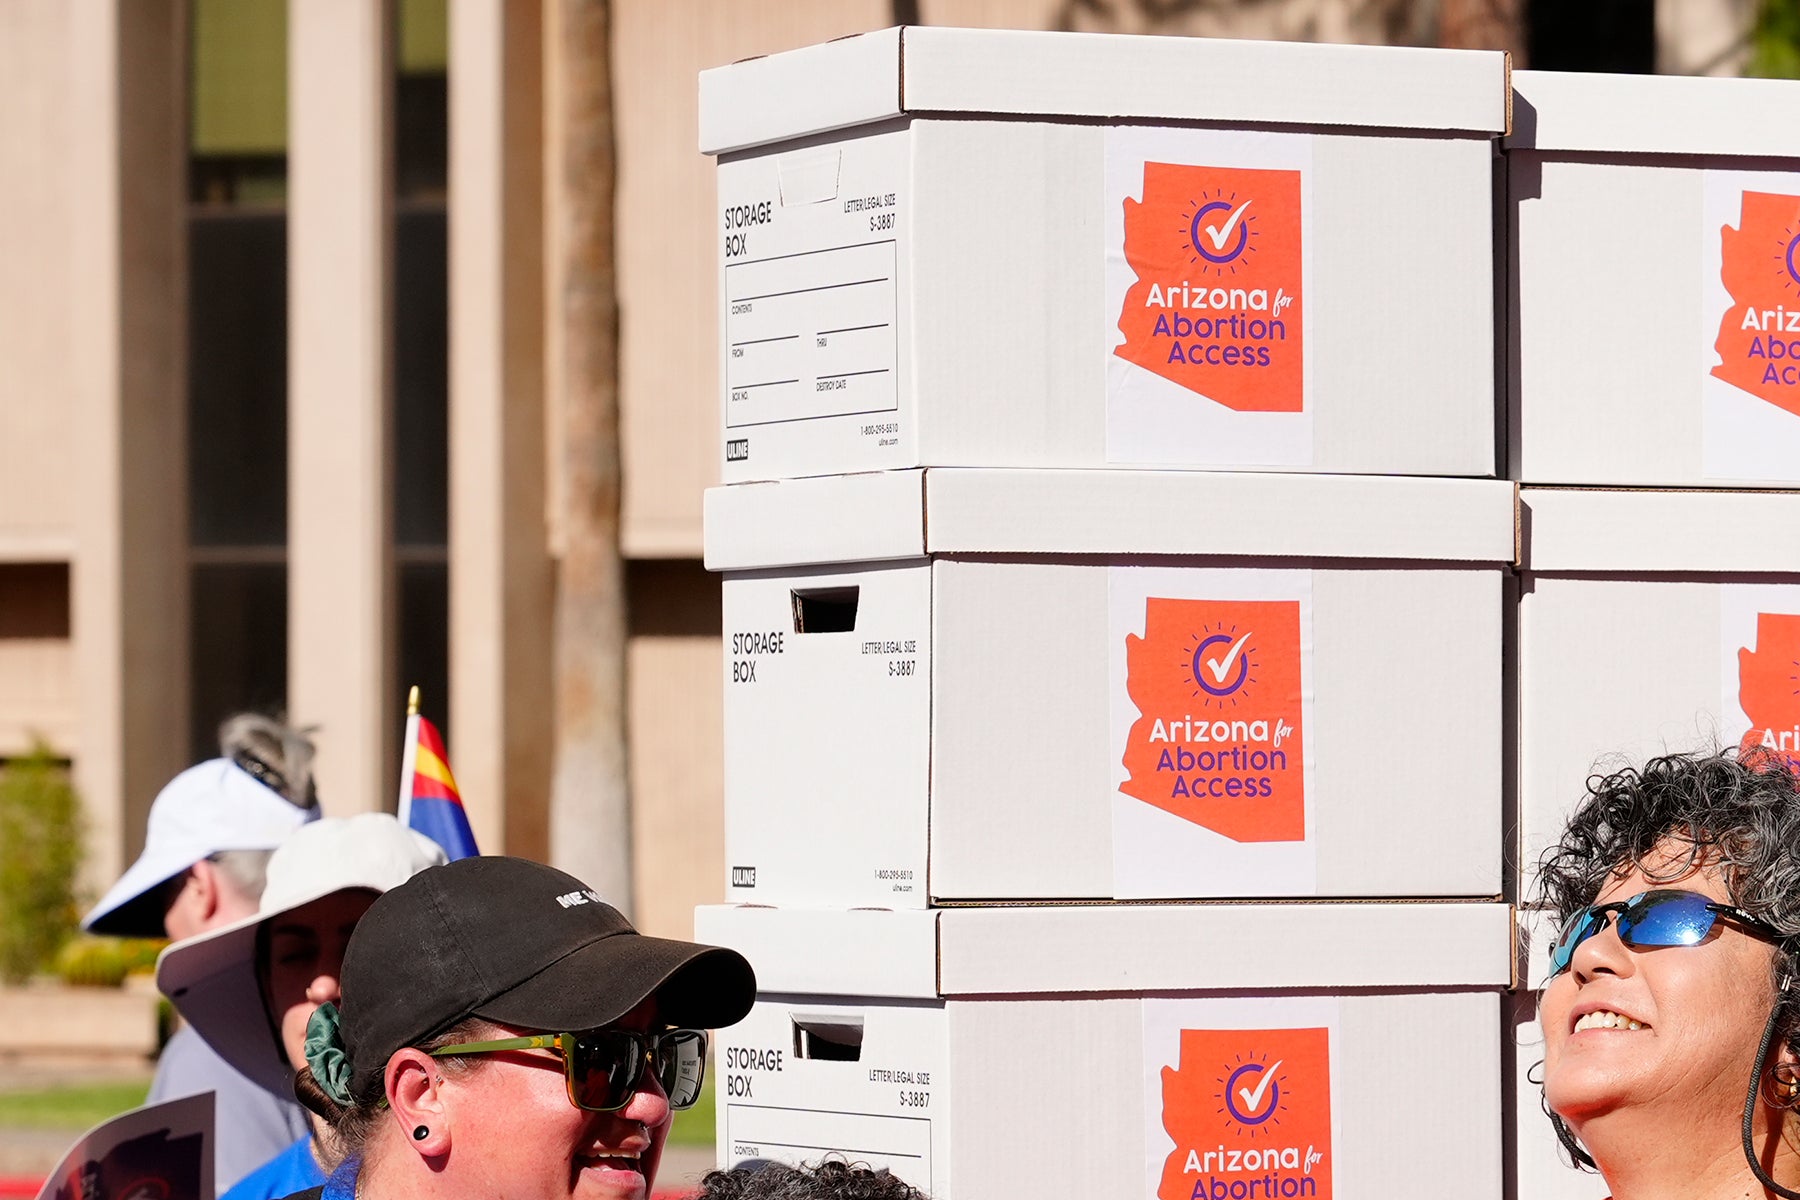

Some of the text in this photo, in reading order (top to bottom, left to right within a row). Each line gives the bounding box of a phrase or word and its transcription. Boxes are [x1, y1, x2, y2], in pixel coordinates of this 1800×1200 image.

[884, 193, 896, 206] SIZE
[725, 201, 771, 229] STORAGE
[869, 213, 896, 231] S-3887
[726, 233, 747, 257] BOX
[1145, 280, 1293, 317] Arizona for
[731, 304, 752, 315] CONTENTS
[1152, 311, 1285, 340] Abortion
[732, 349, 744, 358] FROM
[1167, 340, 1271, 367] Access
[816, 379, 847, 392] DESTROY DATE
[860, 423, 898, 436] 1-800-295-5510
[727, 440, 748, 460] ULINE
[878, 437, 899, 447] uline.com
[733, 631, 784, 655] STORAGE
[904, 641, 916, 653] SIZE
[733, 661, 756, 683] BOX
[888, 660, 916, 676] S-3887
[1149, 715, 1294, 748] Arizona for
[1156, 745, 1286, 771] Abortion
[1171, 775, 1272, 798] Access
[733, 867, 755, 886] ULINE
[874, 869, 913, 880] 1-800-295-5510
[893, 884, 912, 892] uline.com
[727, 1047, 783, 1072] STORAGE
[727, 1075, 753, 1098] BOX
[917, 1072, 930, 1086] SIZE
[900, 1091, 930, 1108] S-3887
[734, 1146, 759, 1157] CONTENTS
[1183, 1144, 1323, 1175] Arizona for
